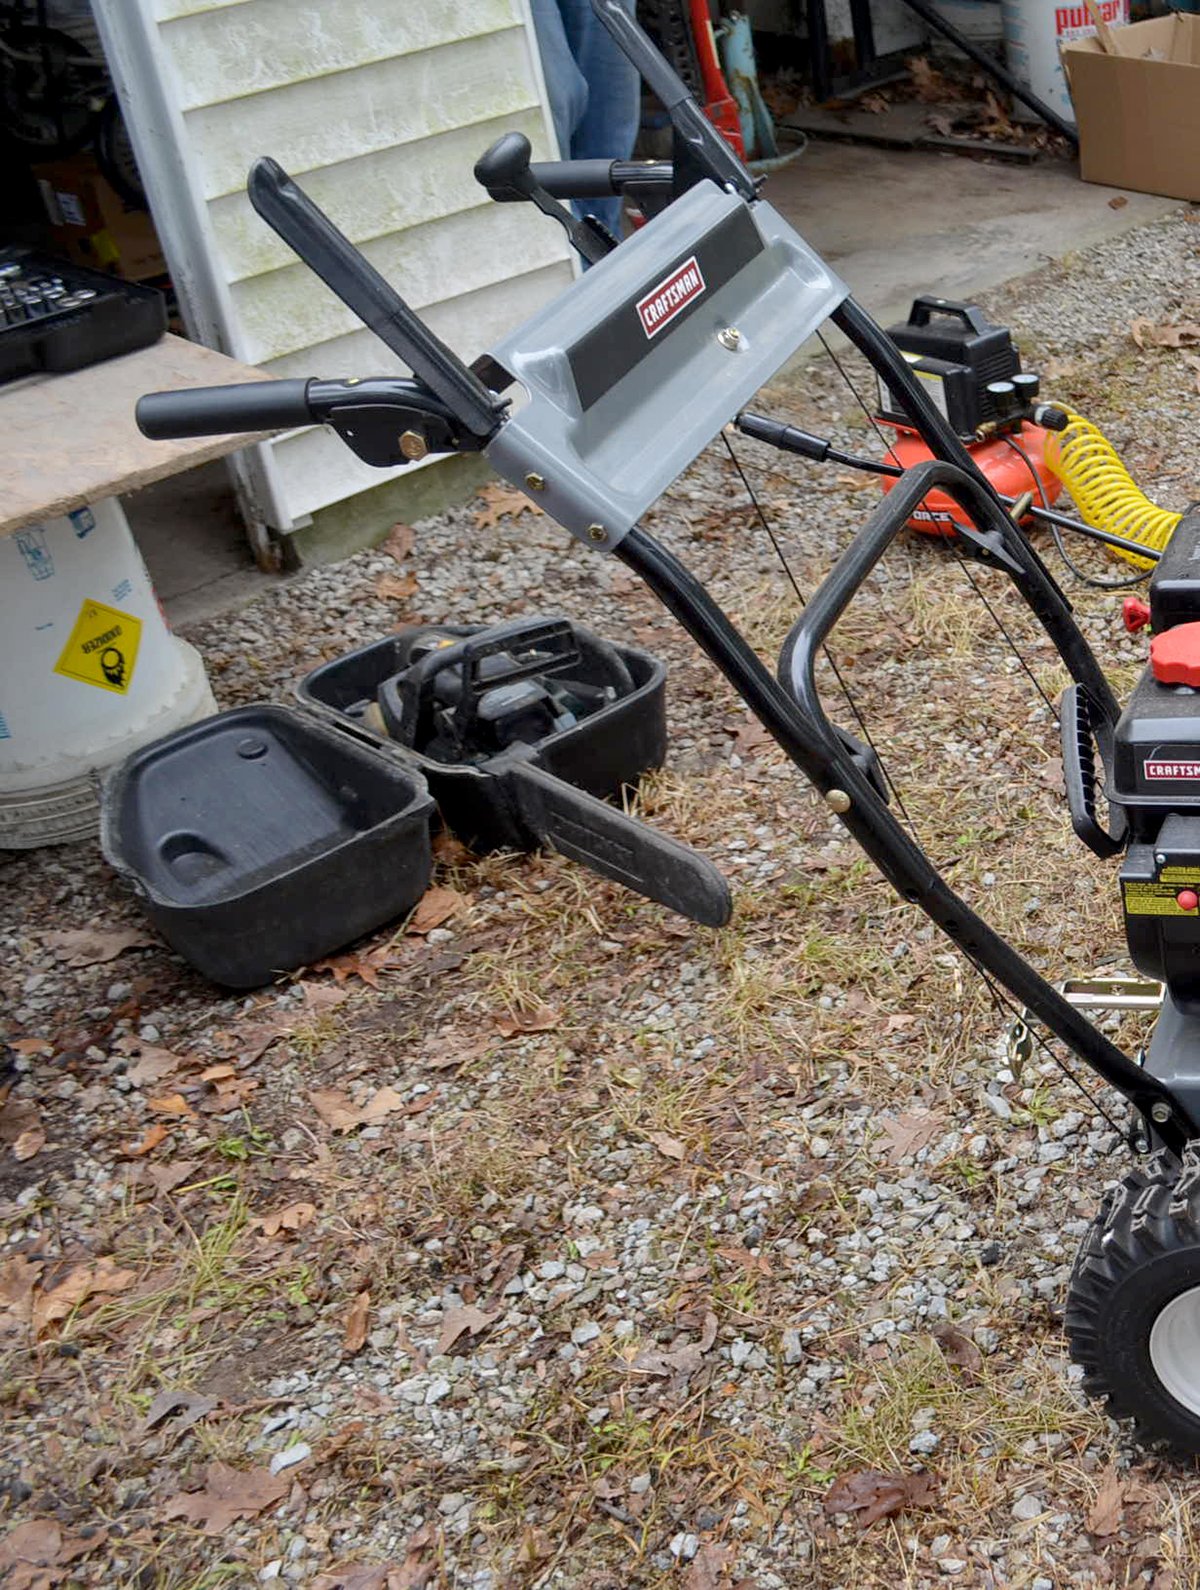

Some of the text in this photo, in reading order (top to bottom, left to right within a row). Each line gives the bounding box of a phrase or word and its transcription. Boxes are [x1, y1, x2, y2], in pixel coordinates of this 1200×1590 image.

[1056, 0, 1120, 35] pular
[643, 268, 699, 327] CRAFTSMAN
[912, 510, 952, 521] ORCE
